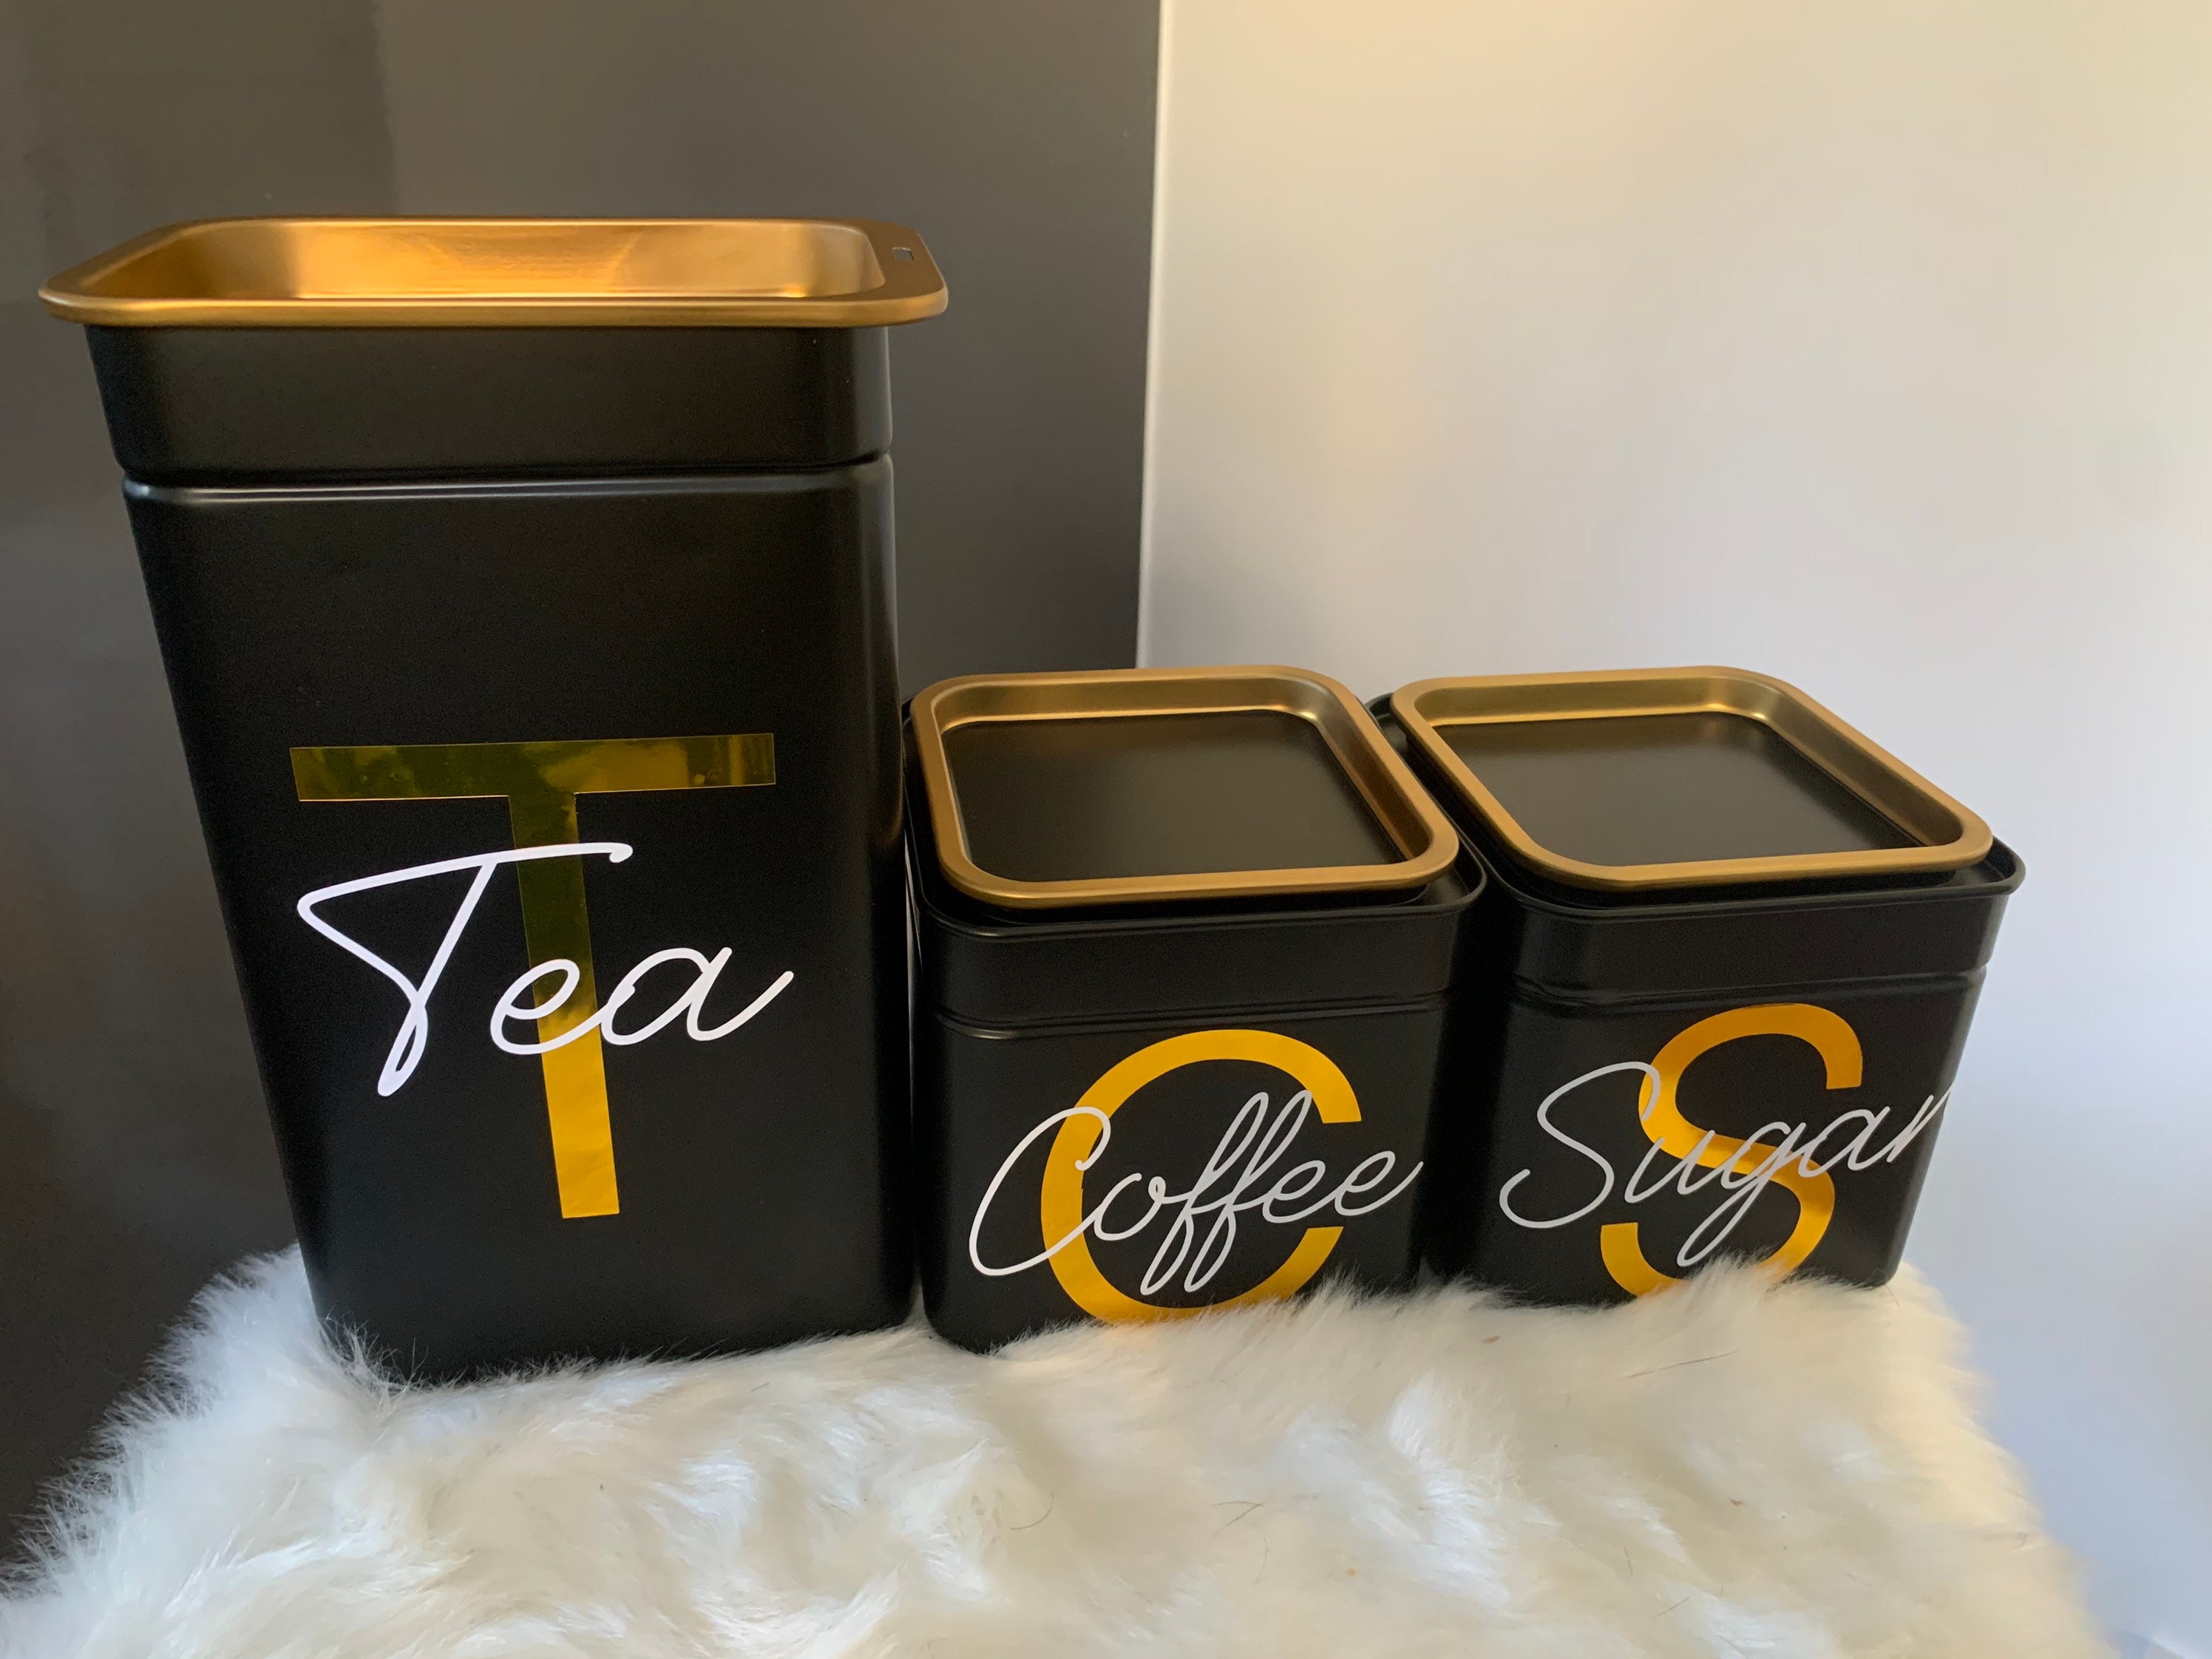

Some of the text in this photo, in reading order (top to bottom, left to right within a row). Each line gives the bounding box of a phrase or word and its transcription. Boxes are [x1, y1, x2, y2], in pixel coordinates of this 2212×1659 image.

[297, 842, 794, 1096] Tea
[968, 1090, 1424, 1296] Coffee
[1041, 1029, 1362, 1326] C
[1601, 1002, 1863, 1298] S
